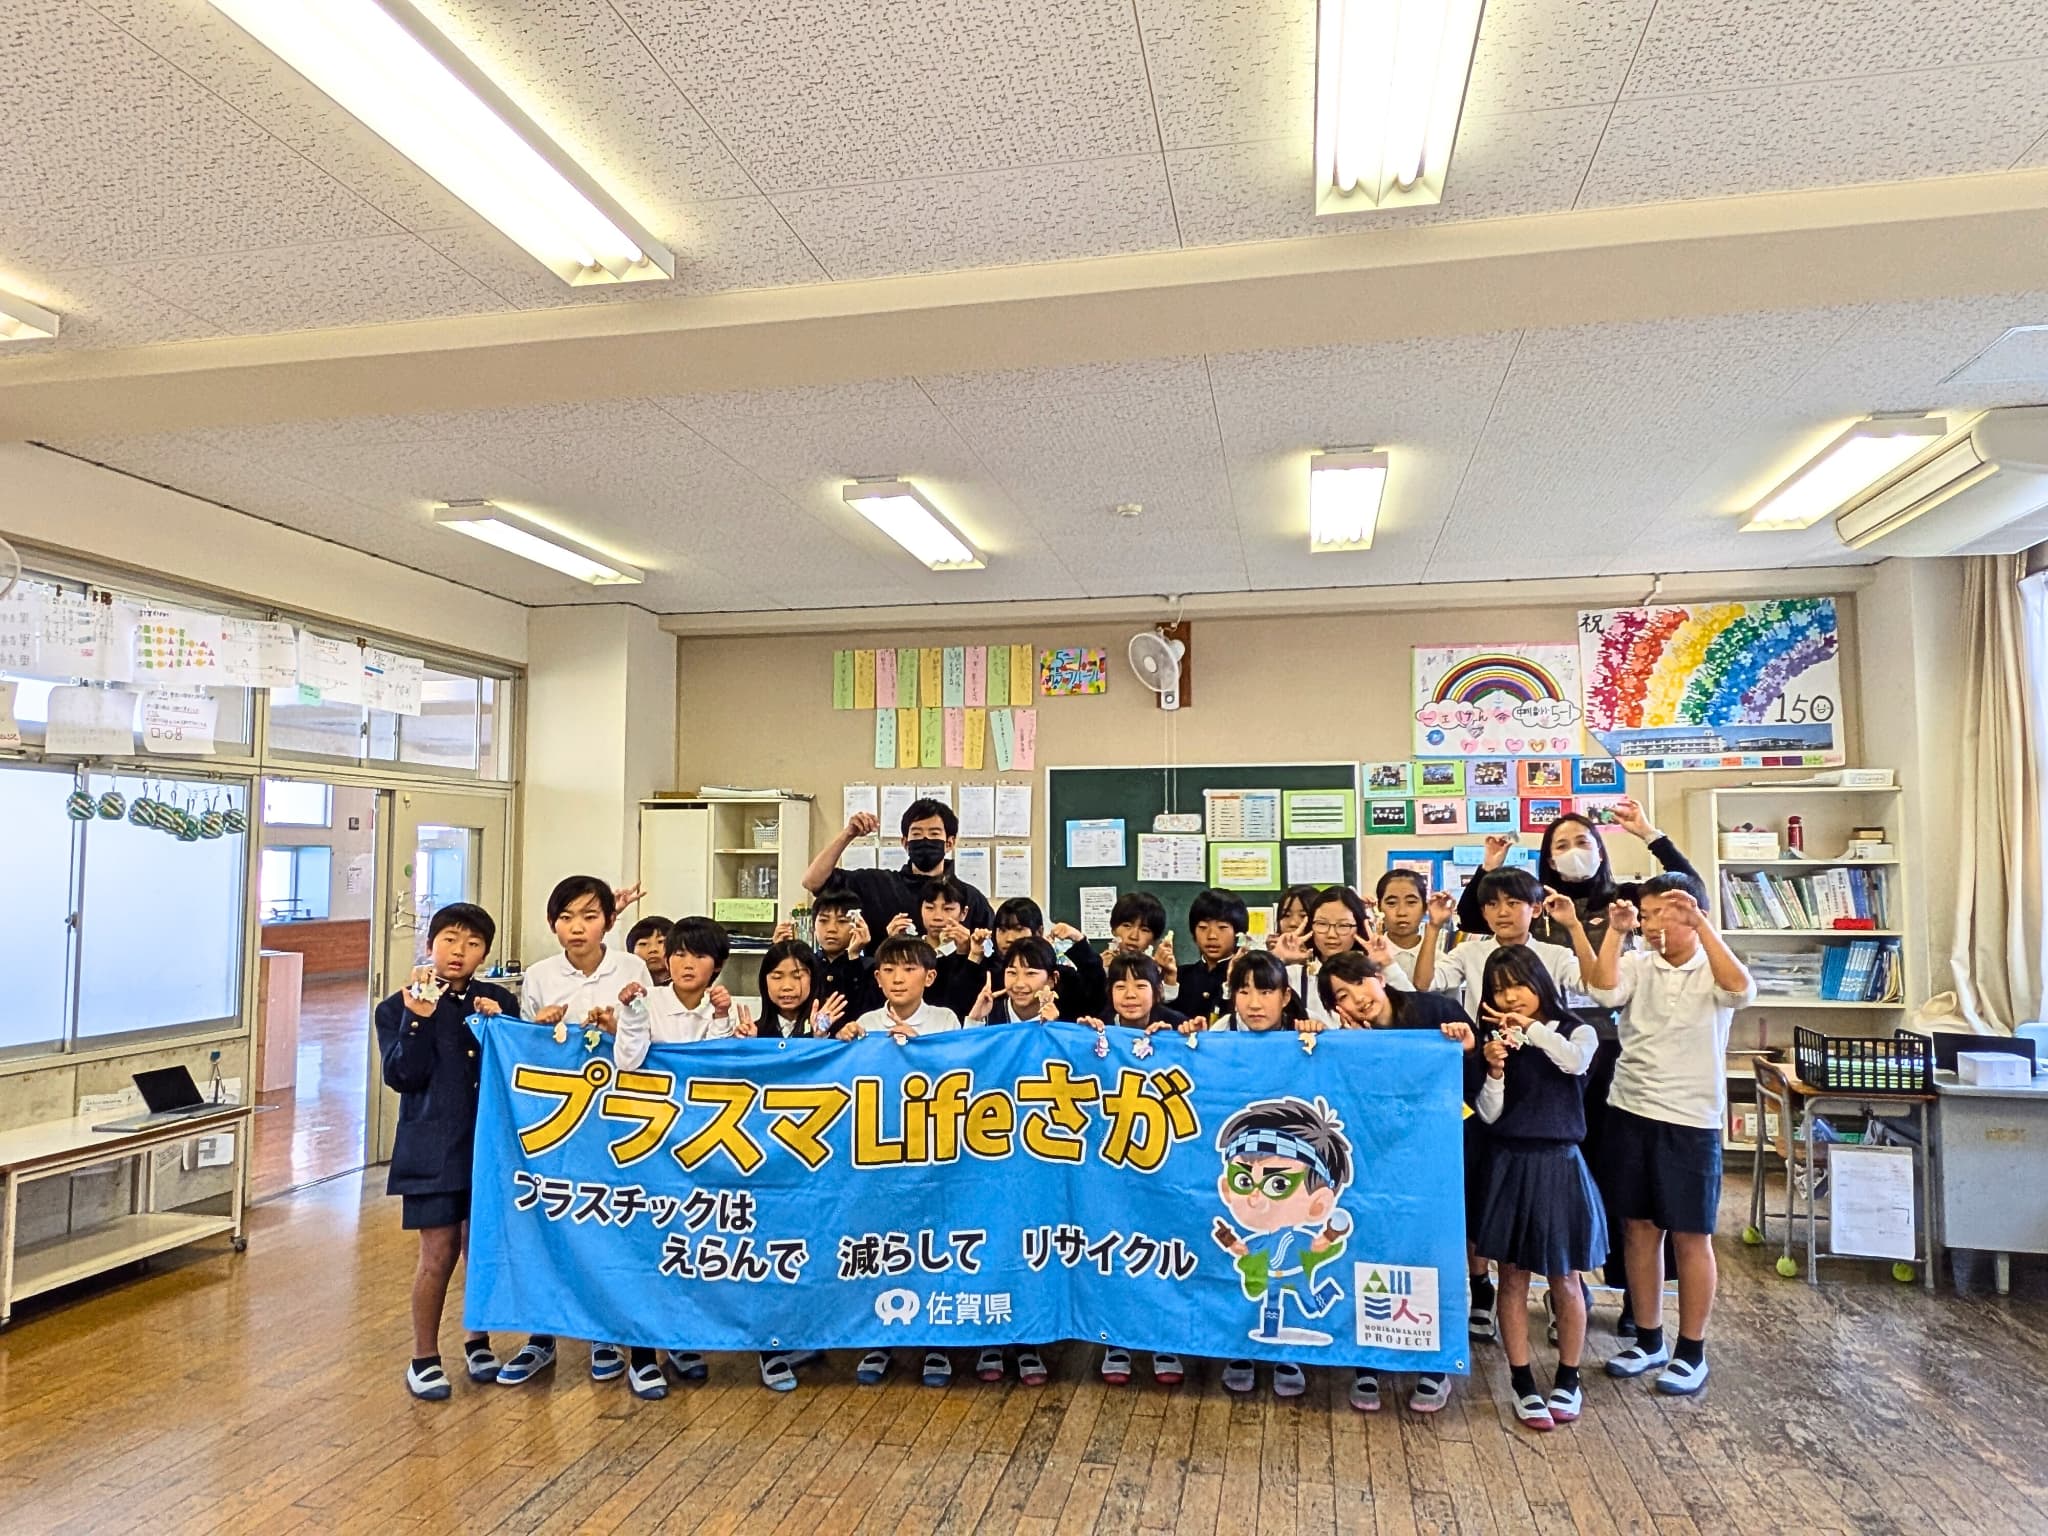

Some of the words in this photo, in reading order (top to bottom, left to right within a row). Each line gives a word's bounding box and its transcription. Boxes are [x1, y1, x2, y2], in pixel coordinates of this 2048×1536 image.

[1579, 614, 1605, 634] 祝
[1776, 693, 1834, 724] 150
[512, 1058, 1201, 1175] プラスマLifeさが
[514, 1172, 756, 1233] プラスチックは
[659, 1234, 808, 1283] えらんで
[838, 1228, 987, 1279] 減らして
[1022, 1226, 1198, 1280] リサイクル
[927, 1291, 1013, 1326] 佐賀県
[1364, 1332, 1431, 1347] PROJECT
